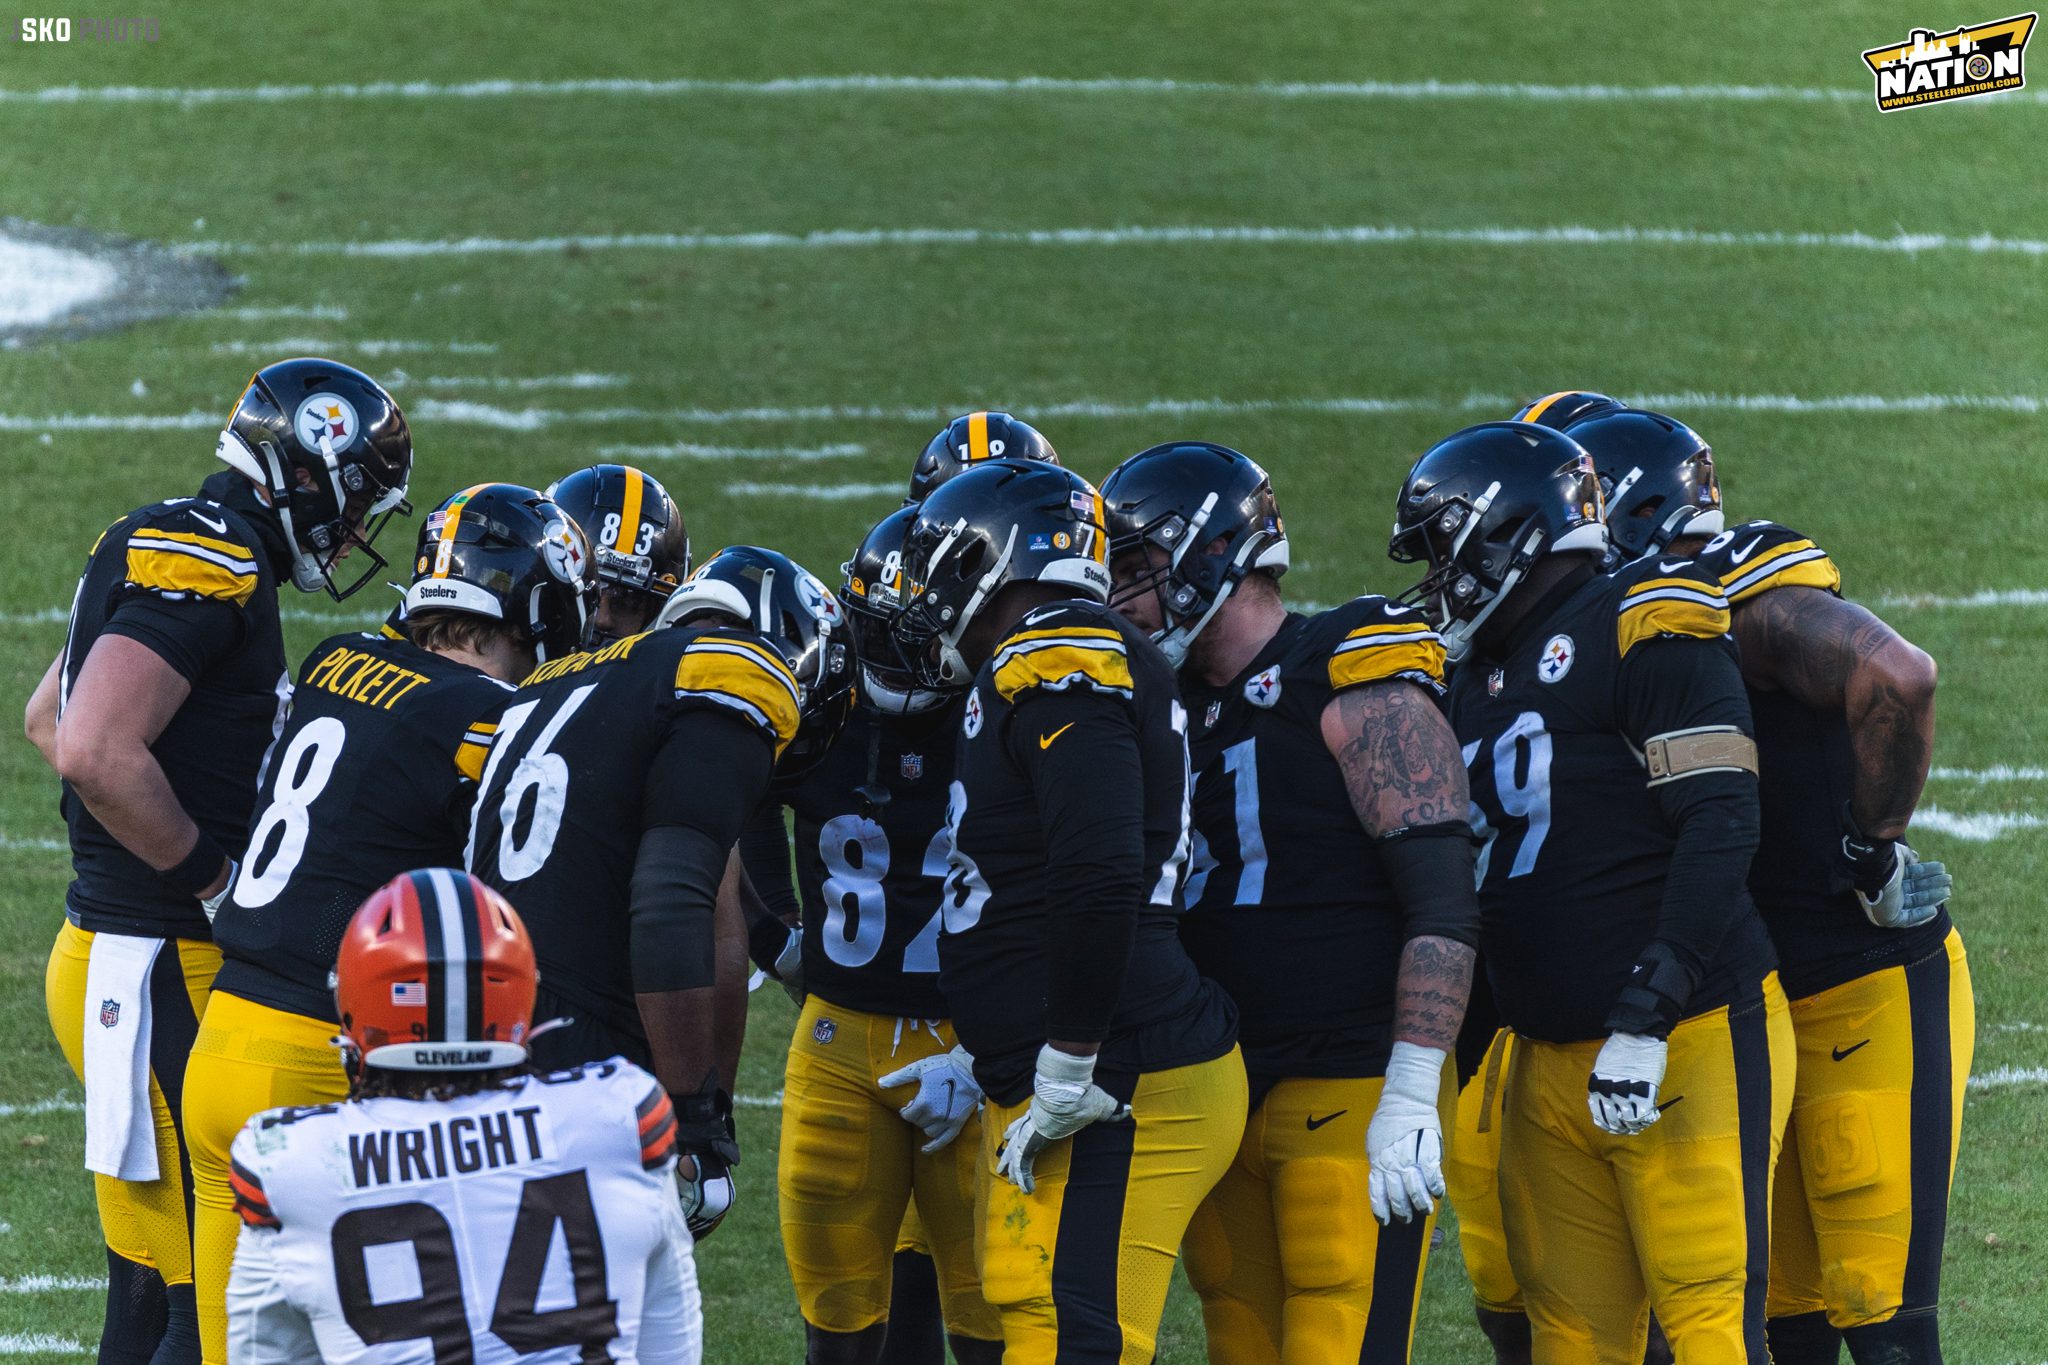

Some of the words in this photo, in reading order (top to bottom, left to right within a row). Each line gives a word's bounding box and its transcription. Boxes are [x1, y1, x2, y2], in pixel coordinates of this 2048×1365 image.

[419, 584, 458, 600] Steelers
[436, 539, 453, 574] 8
[306, 646, 432, 710] PICKETT
[233, 716, 346, 909] 8
[464, 683, 599, 882] 76
[415, 1048, 493, 1065] CLEVELAND
[348, 1105, 543, 1189] WRIGHT
[331, 1169, 619, 1365] 94
